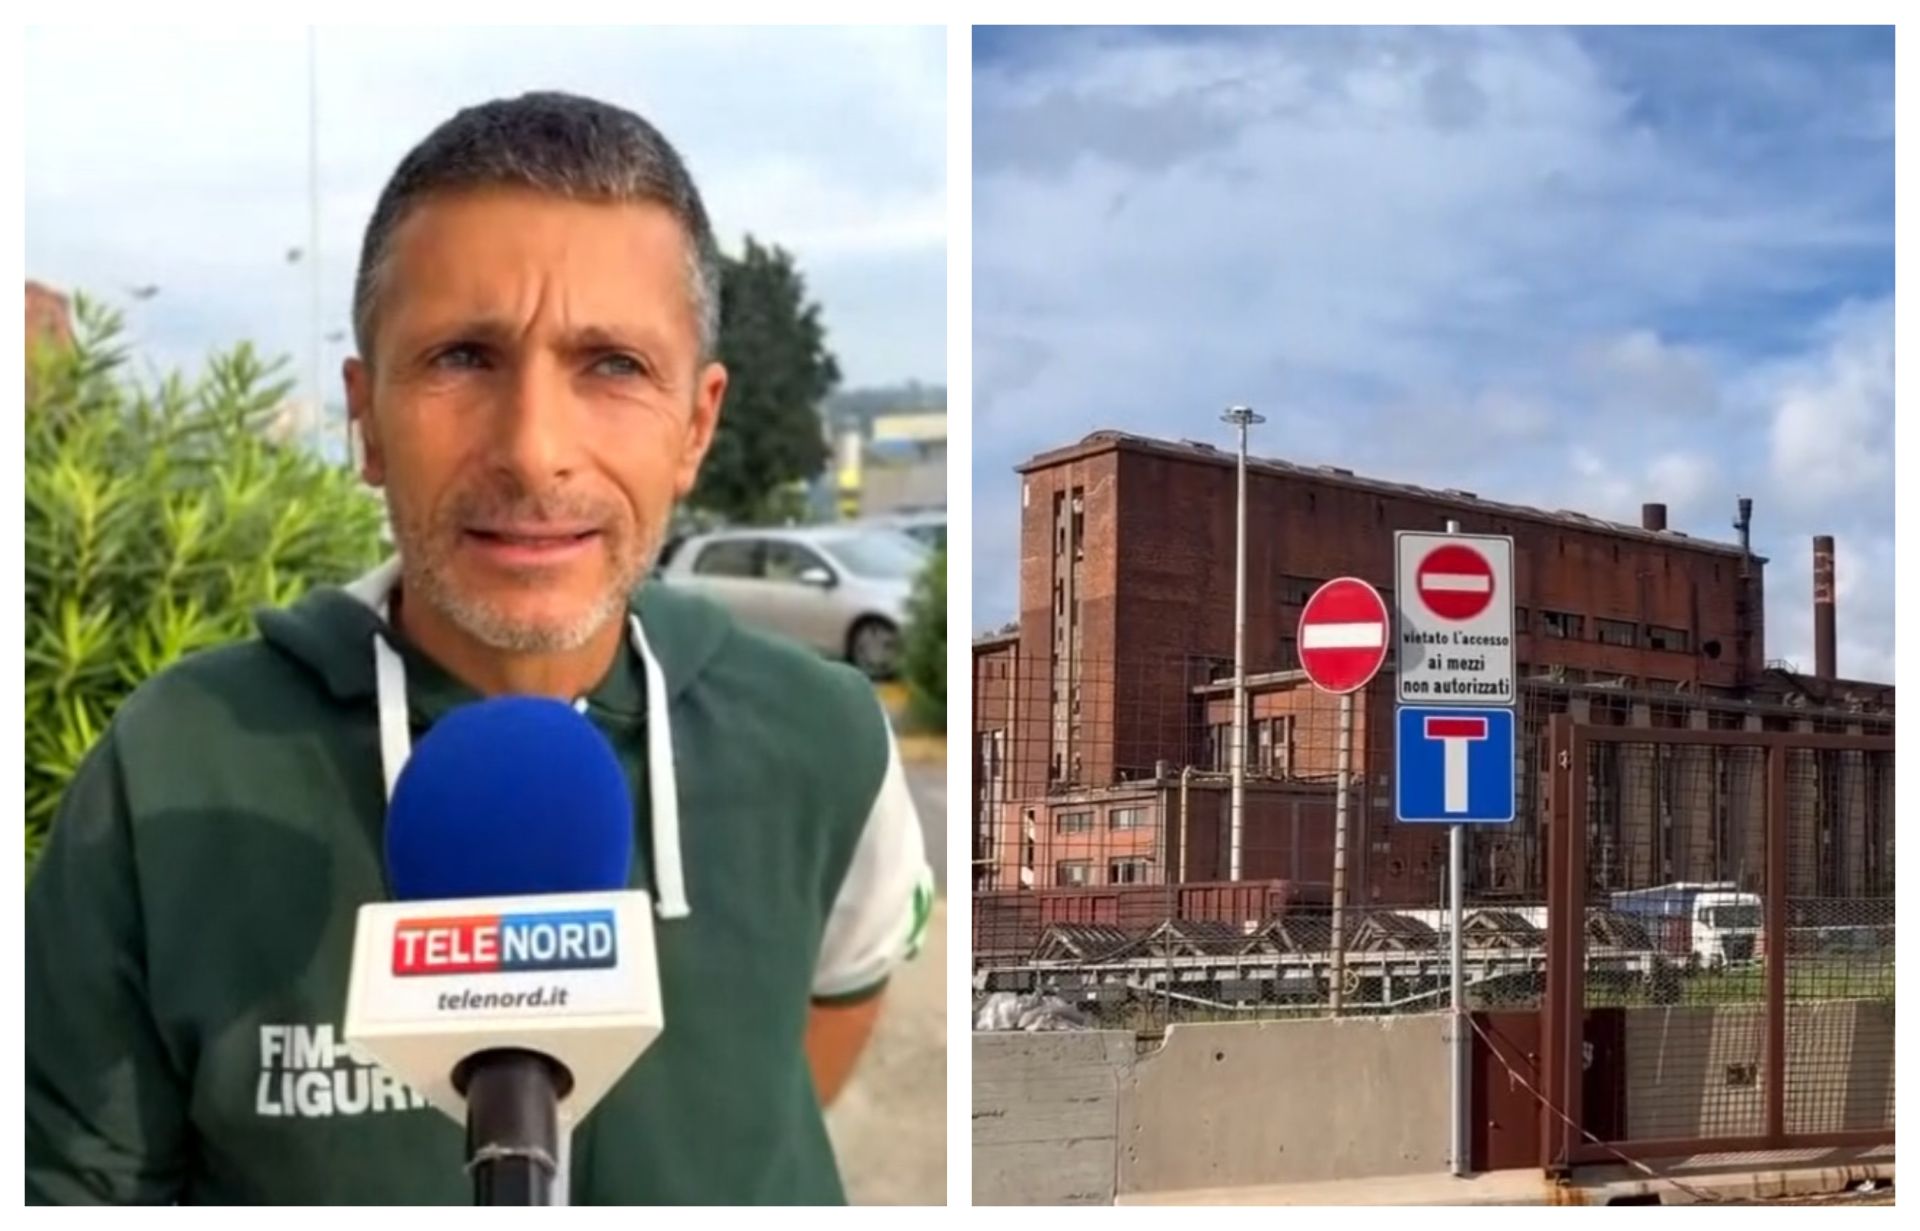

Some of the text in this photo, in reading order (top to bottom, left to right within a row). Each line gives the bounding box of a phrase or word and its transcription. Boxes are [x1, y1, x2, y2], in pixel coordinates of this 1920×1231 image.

[1403, 630, 1509, 646] vietato l'accesso
[1428, 653, 1485, 671] ai mezzi
[1403, 678, 1510, 695] non autorizzati
[396, 922, 612, 966] TELENORD
[438, 986, 569, 1011] telenord.it
